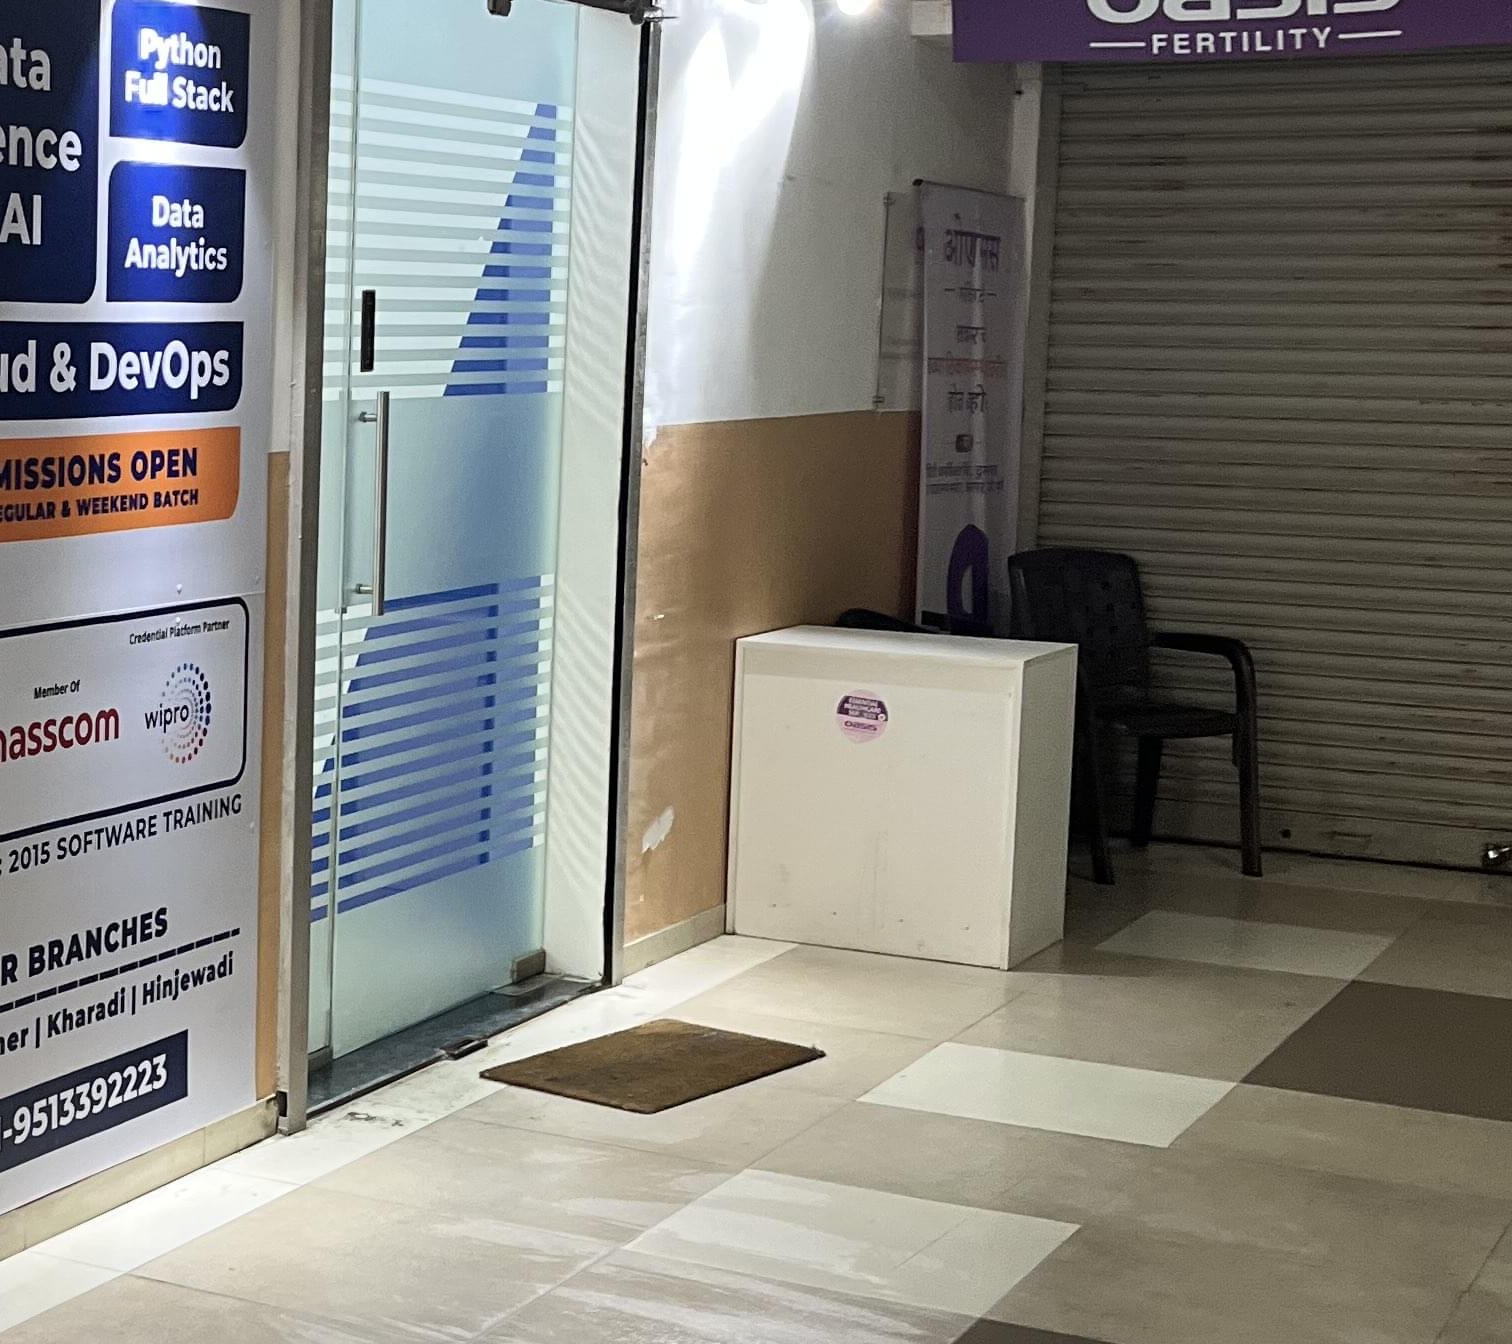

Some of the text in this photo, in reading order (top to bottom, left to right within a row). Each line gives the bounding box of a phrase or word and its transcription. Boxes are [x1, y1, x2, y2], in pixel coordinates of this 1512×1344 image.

[139, 28, 221, 70] Python
[1151, 27, 1332, 55] FERTILITY
[125, 70, 234, 113] Full Stack
[152, 195, 204, 228] Data
[124, 236, 227, 277] Analytics
[49, 342, 77, 393] &
[90, 340, 230, 400] DevOps
[131, 447, 198, 482] OPEN
[61, 500, 71, 518] &
[76, 493, 149, 516] WEEKEND
[153, 488, 199, 508] BATCH
[129, 619, 230, 645] Credential Platform Partner
[34, 679, 80, 699] Member Of
[144, 703, 189, 733] wipro
[8, 842, 51, 873] 2015
[57, 815, 158, 861] SOFTWARE
[163, 794, 242, 832] TRAINING
[28, 907, 168, 978] BRANCHES
[47, 987, 126, 1038] Kharadi
[142, 951, 233, 1006] Hinjewadi
